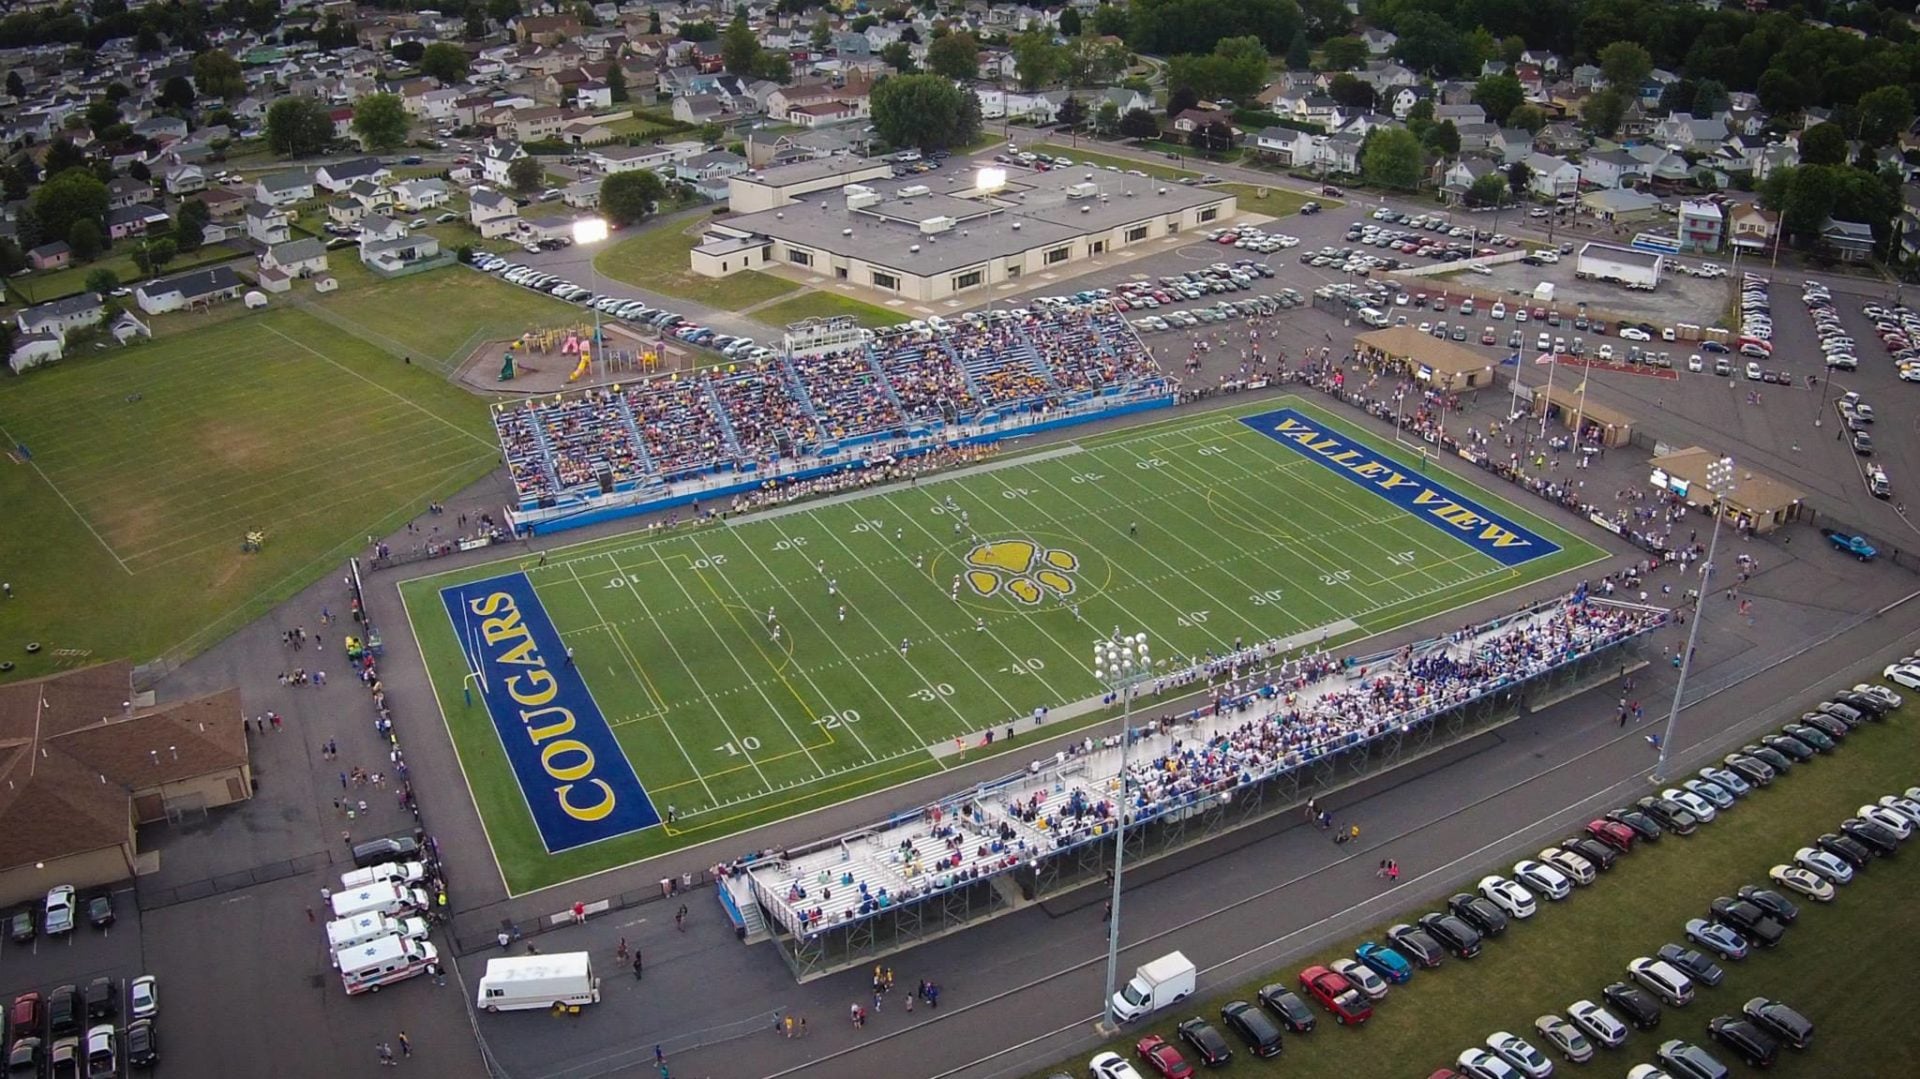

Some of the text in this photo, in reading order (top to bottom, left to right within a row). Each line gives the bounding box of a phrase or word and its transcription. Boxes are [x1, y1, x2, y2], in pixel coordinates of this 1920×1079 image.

[1274, 418, 1420, 490] VALLEY
[1412, 488, 1532, 548] VIEW
[469, 592, 616, 821] COUGARS
